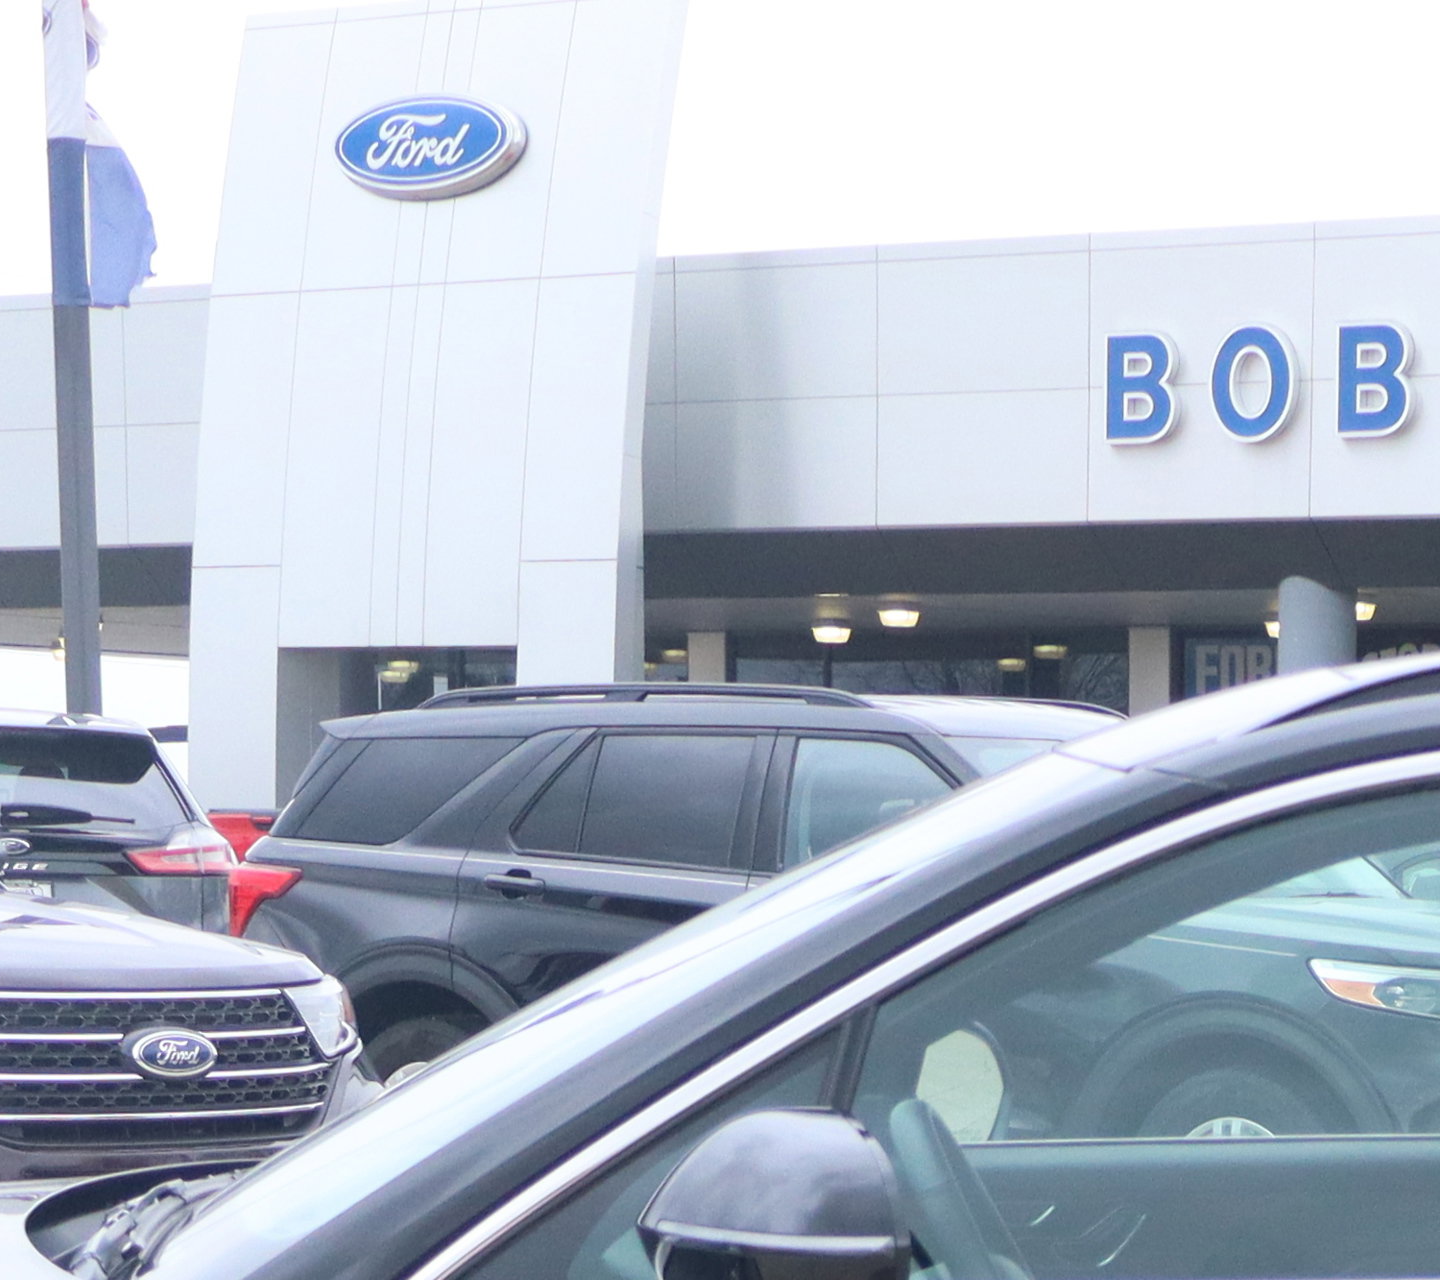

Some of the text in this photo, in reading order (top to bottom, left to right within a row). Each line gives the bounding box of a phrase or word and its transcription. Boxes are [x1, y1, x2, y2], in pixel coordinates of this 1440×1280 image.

[366, 113, 470, 170] Ford
[1105, 322, 1410, 440] BOB
[1195, 643, 1278, 700] FOR
[156, 1039, 200, 1066] Ford
